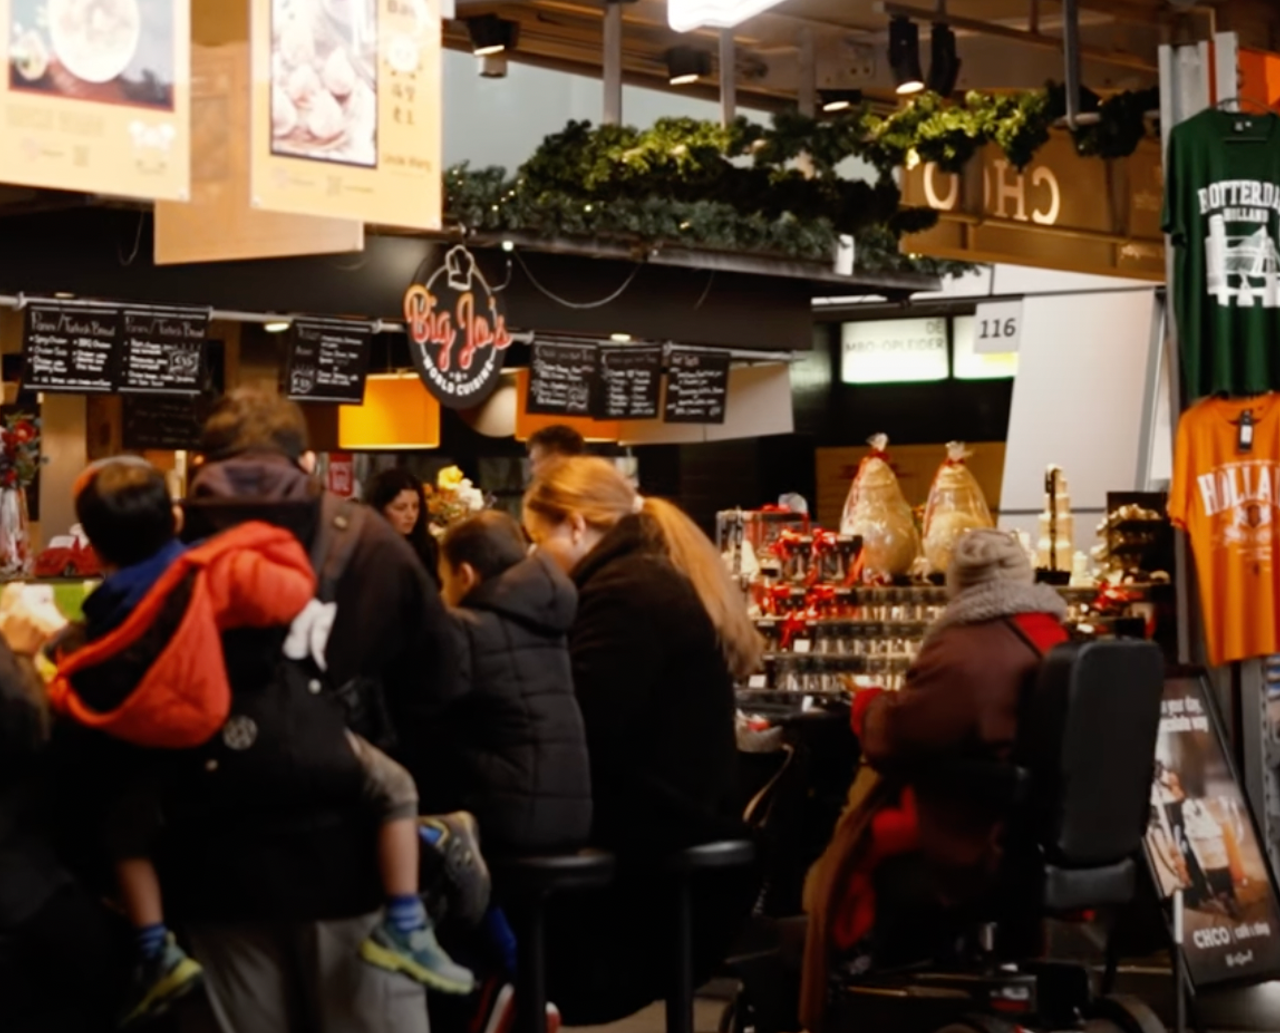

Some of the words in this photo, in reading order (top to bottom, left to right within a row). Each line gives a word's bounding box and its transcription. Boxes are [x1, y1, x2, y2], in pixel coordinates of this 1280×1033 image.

[404, 284, 457, 372] Big
[978, 318, 1017, 339] 116
[422, 355, 455, 394] WORLD
[456, 359, 495, 396] CUISINE
[1193, 925, 1231, 949] CHCO
